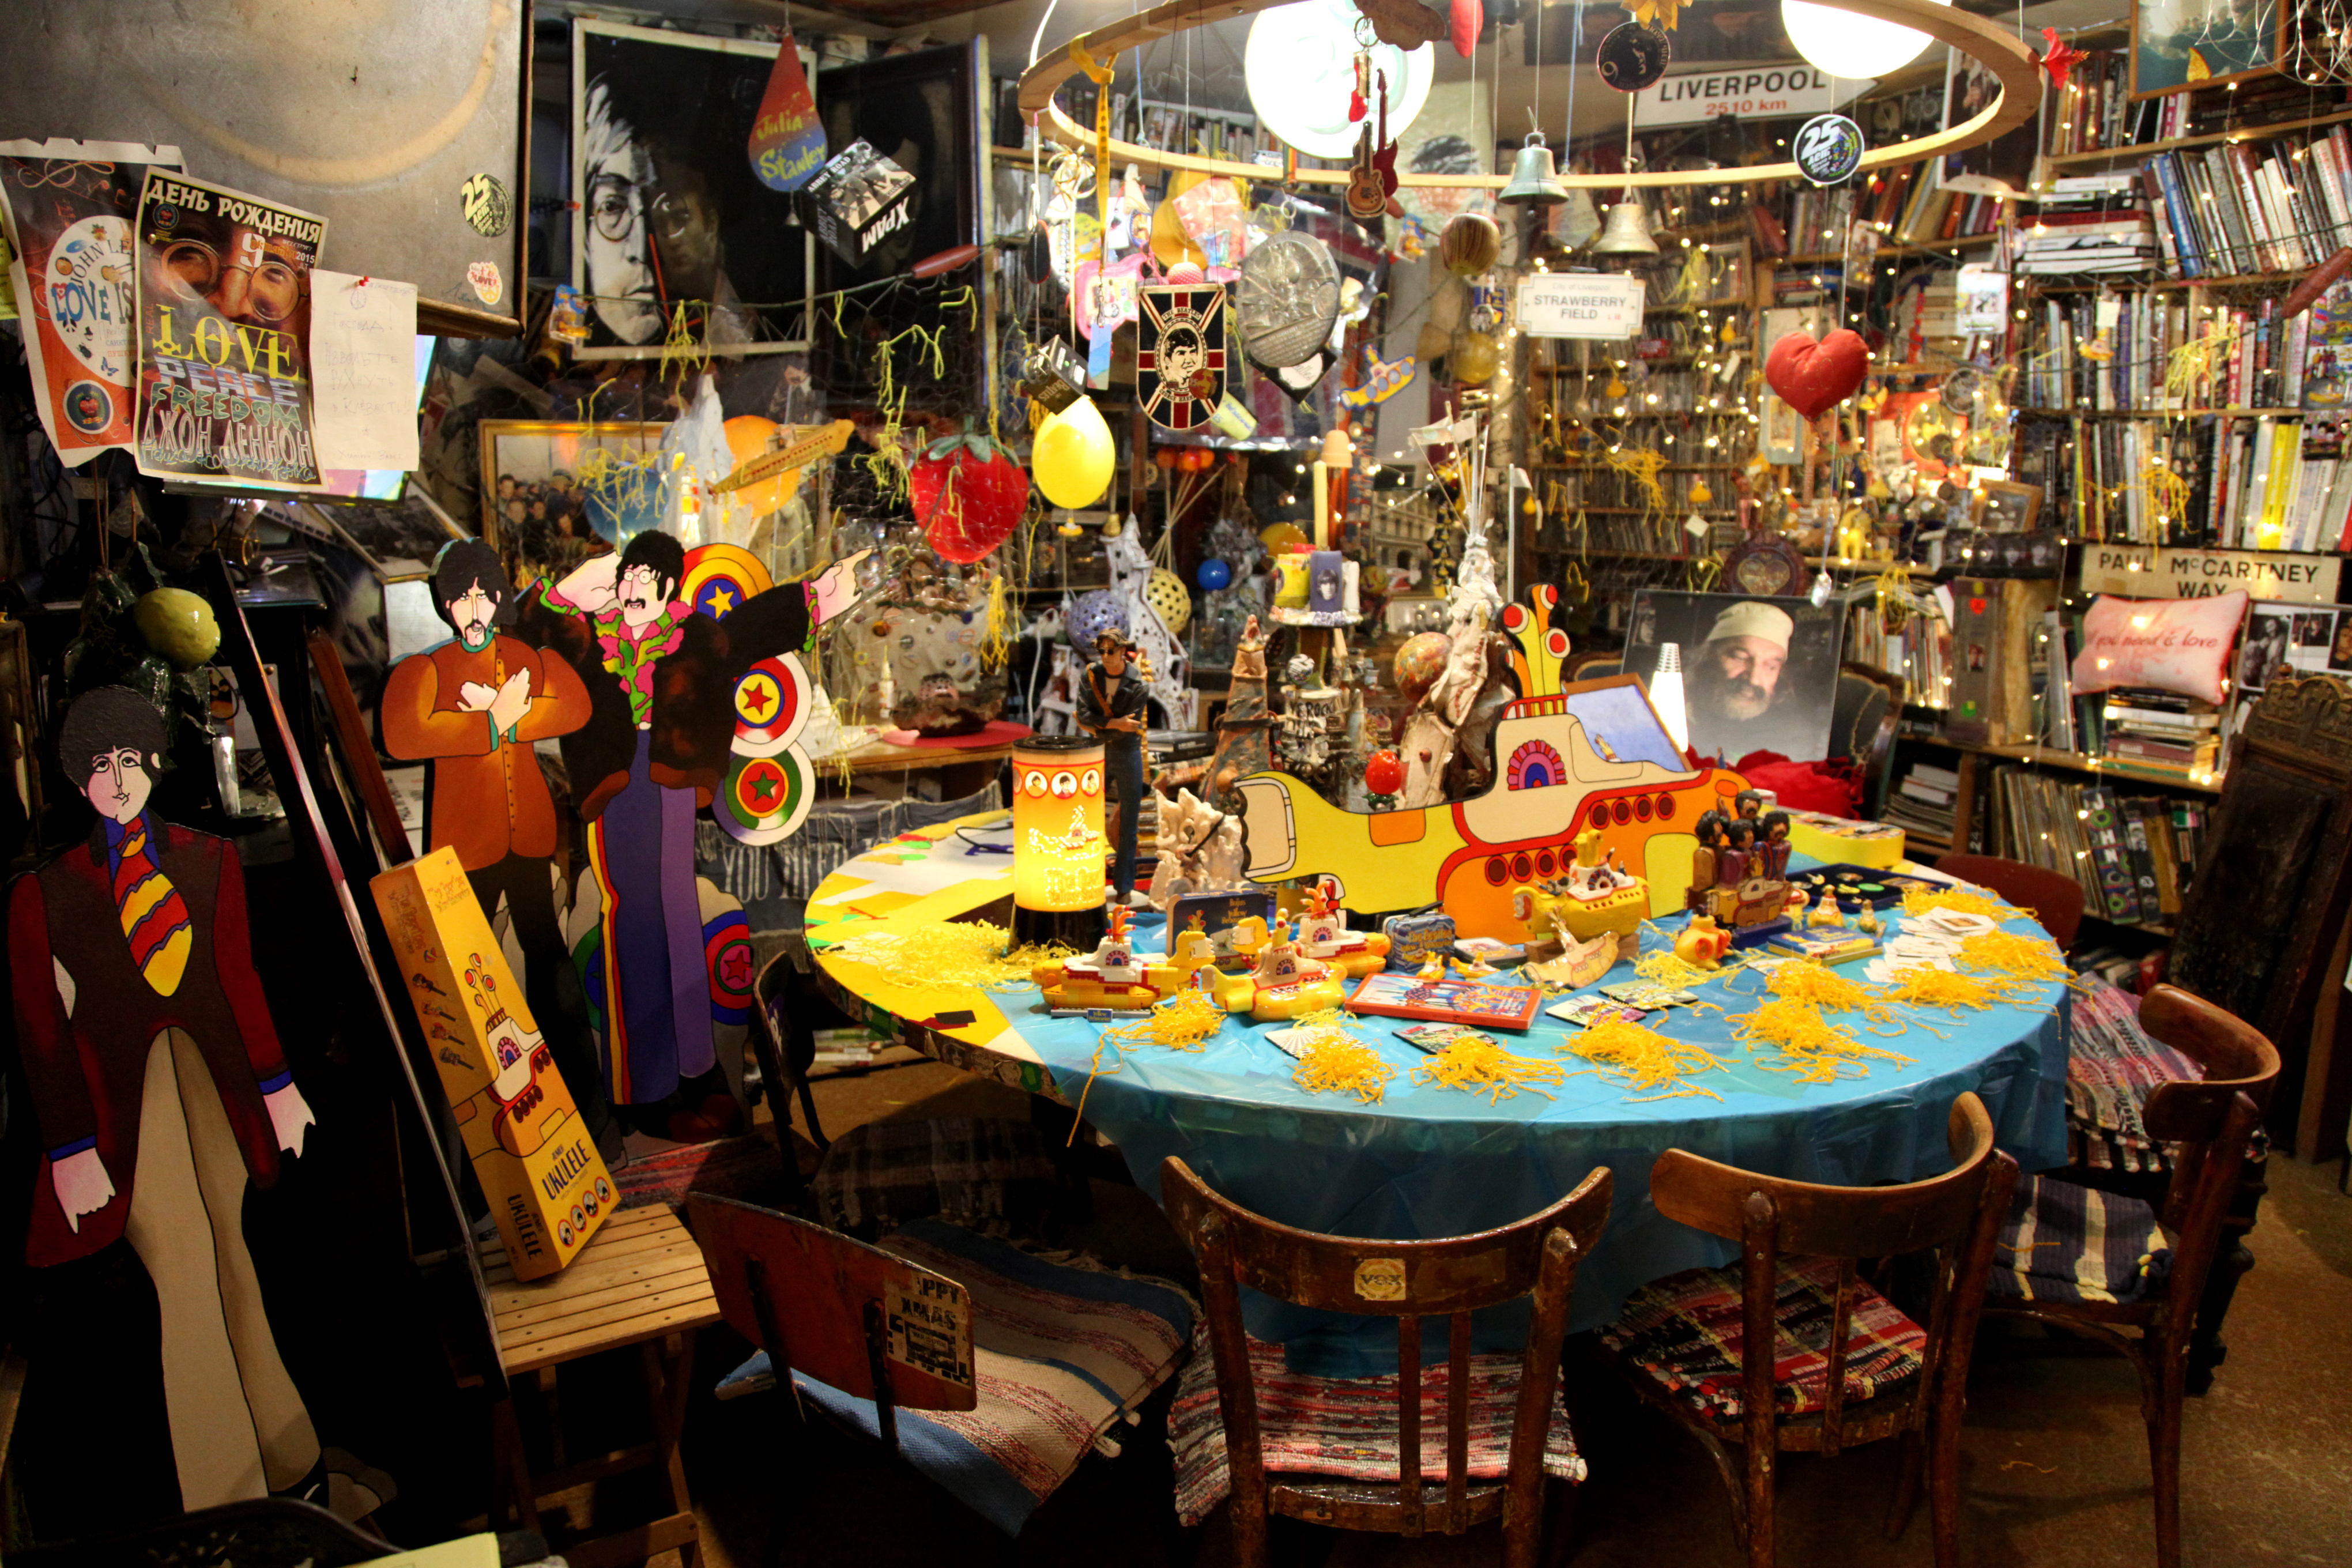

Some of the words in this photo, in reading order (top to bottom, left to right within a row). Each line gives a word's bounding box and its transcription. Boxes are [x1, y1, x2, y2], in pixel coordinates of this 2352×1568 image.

[1660, 69, 1827, 101] LIVERPOOL
[1705, 100, 1752, 116] 2510
[1758, 99, 1787, 111] km
[757, 110, 803, 140] Julia
[1800, 118, 1844, 160] 25
[759, 143, 826, 180] Stanley
[808, 172, 831, 193] ABBEY
[830, 156, 851, 174] ROAD
[146, 179, 210, 212] ДЕНЬ
[217, 197, 321, 243] РОЖДЕНИЯ
[462, 173, 491, 221] 25
[240, 232, 266, 268] 9
[296, 251, 315, 264] 2015
[51, 280, 112, 325] LOVE
[114, 281, 134, 324] IS
[1163, 310, 1174, 319] THE
[1177, 307, 1203, 319] BEATLES
[1535, 295, 1627, 307] STRAWBERRY
[1561, 308, 1598, 319] FIELD
[153, 304, 299, 381] LOVE
[154, 355, 300, 408] PEACE
[1159, 389, 1177, 402] GEORGE
[150, 382, 302, 431] FREEDOM
[142, 406, 212, 458] ДЖОН
[223, 420, 314, 468] ЛЕННОН
[2099, 552, 2153, 572] PAUL
[2170, 557, 2319, 583] McCARTNEY
[2177, 580, 2227, 598] WAY
[2182, 629, 2218, 648] love
[542, 1139, 591, 1200] UKULELE
[507, 1194, 544, 1260] UKULELE
[916, 1277, 959, 1305] PPY
[1359, 1273, 1402, 1286] VOX
